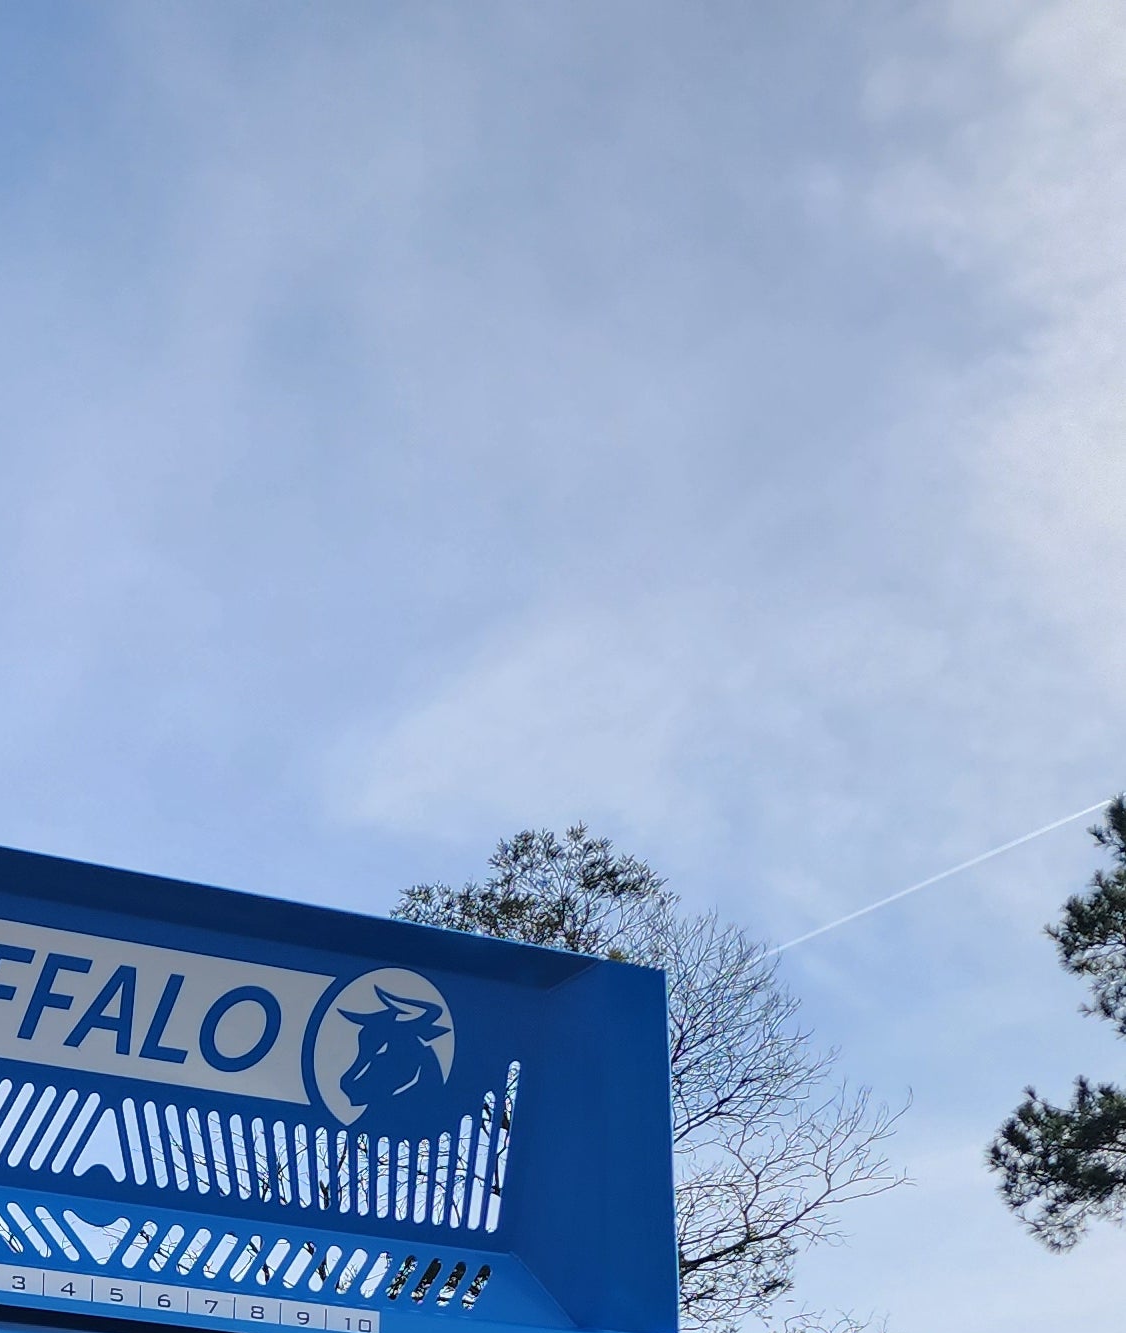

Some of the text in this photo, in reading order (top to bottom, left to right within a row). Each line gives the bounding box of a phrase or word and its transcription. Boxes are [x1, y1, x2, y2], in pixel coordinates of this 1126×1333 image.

[11, 1275, 26, 1290] 3
[60, 1281, 76, 1296] 4
[109, 1287, 124, 1302] 5
[157, 1294, 172, 1308] 6
[204, 1299, 219, 1314] 7
[250, 1305, 265, 1320] 8
[296, 1311, 310, 1325] 9
[344, 1317, 372, 1333] 10
